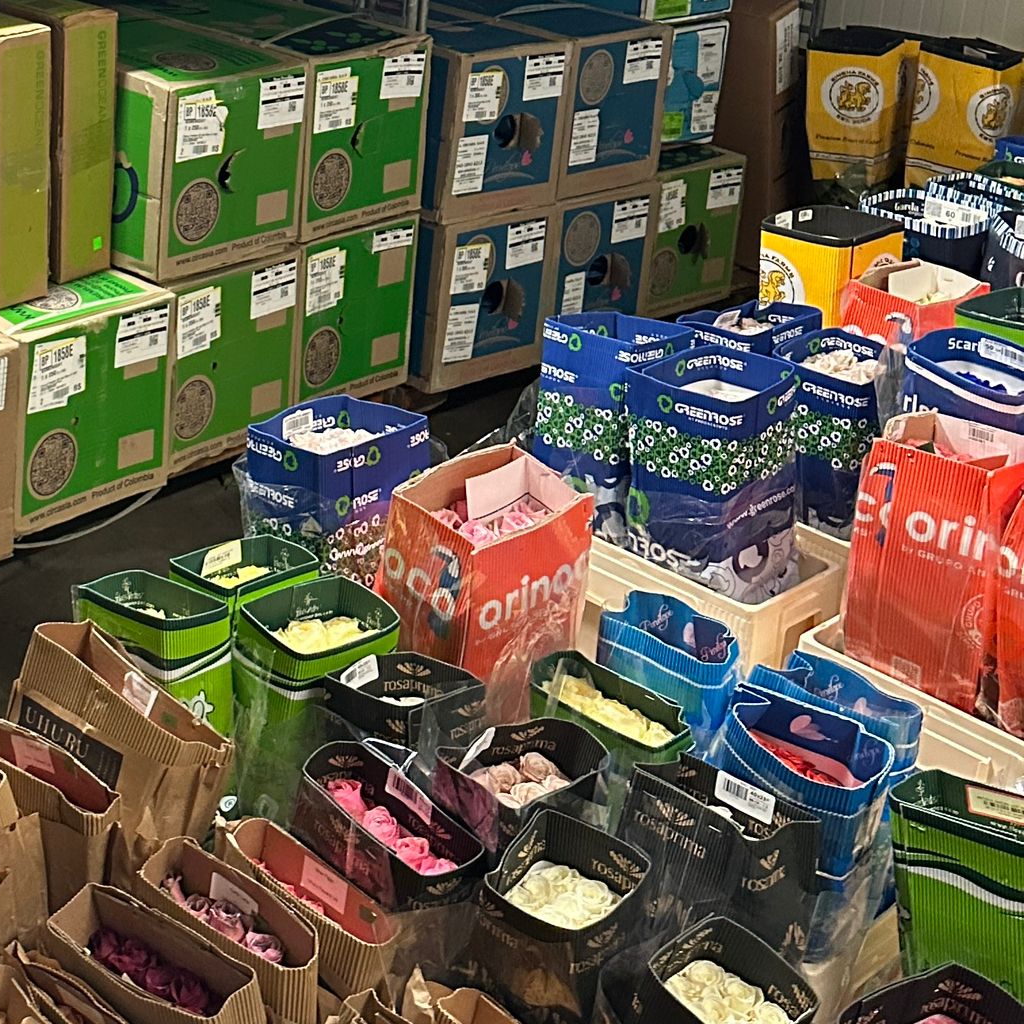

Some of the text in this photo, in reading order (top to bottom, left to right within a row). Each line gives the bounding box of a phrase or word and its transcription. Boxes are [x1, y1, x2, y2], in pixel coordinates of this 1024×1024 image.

[332, 81, 348, 94] 1858E
[185, 105, 193, 117] BP
[361, 205, 381, 218] Product
[945, 210, 956, 218] 60
[232, 239, 253, 251] Product
[260, 231, 287, 244] Colombia
[192, 295, 210, 313] 1858E
[41, 344, 74, 366] BP 1858E
[687, 353, 745, 371] GREENROSE
[802, 380, 870, 407] GREENROSE
[675, 403, 745, 426] GREENROSE
[91, 485, 116, 499] Product
[116, 481, 123, 490] of
[124, 471, 155, 488] Colombia
[918, 548, 963, 571] GRUPO
[384, 678, 445, 699] rosaprima
[25, 706, 90, 758] UHURU
[634, 809, 707, 860] rosaprima
